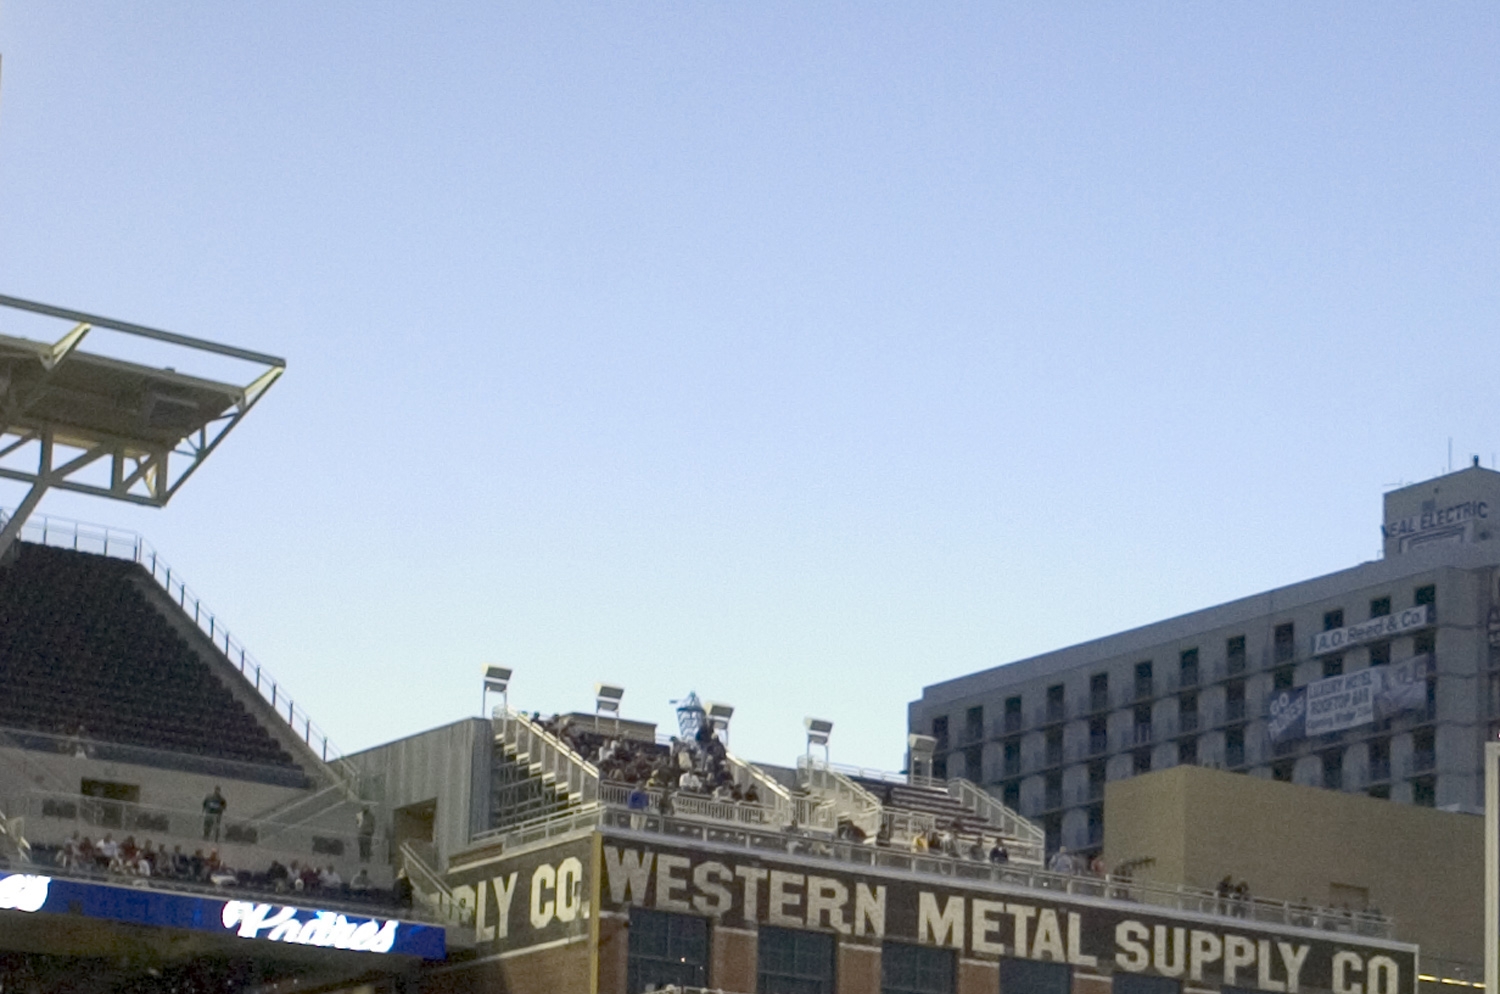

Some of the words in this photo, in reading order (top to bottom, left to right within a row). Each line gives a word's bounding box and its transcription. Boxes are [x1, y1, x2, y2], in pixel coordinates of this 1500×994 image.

[1420, 501, 1488, 530] ELECTRIC
[602, 844, 887, 938] WESTERN
[918, 890, 1098, 967] METAL
[1115, 919, 1311, 994] SUPPLY
